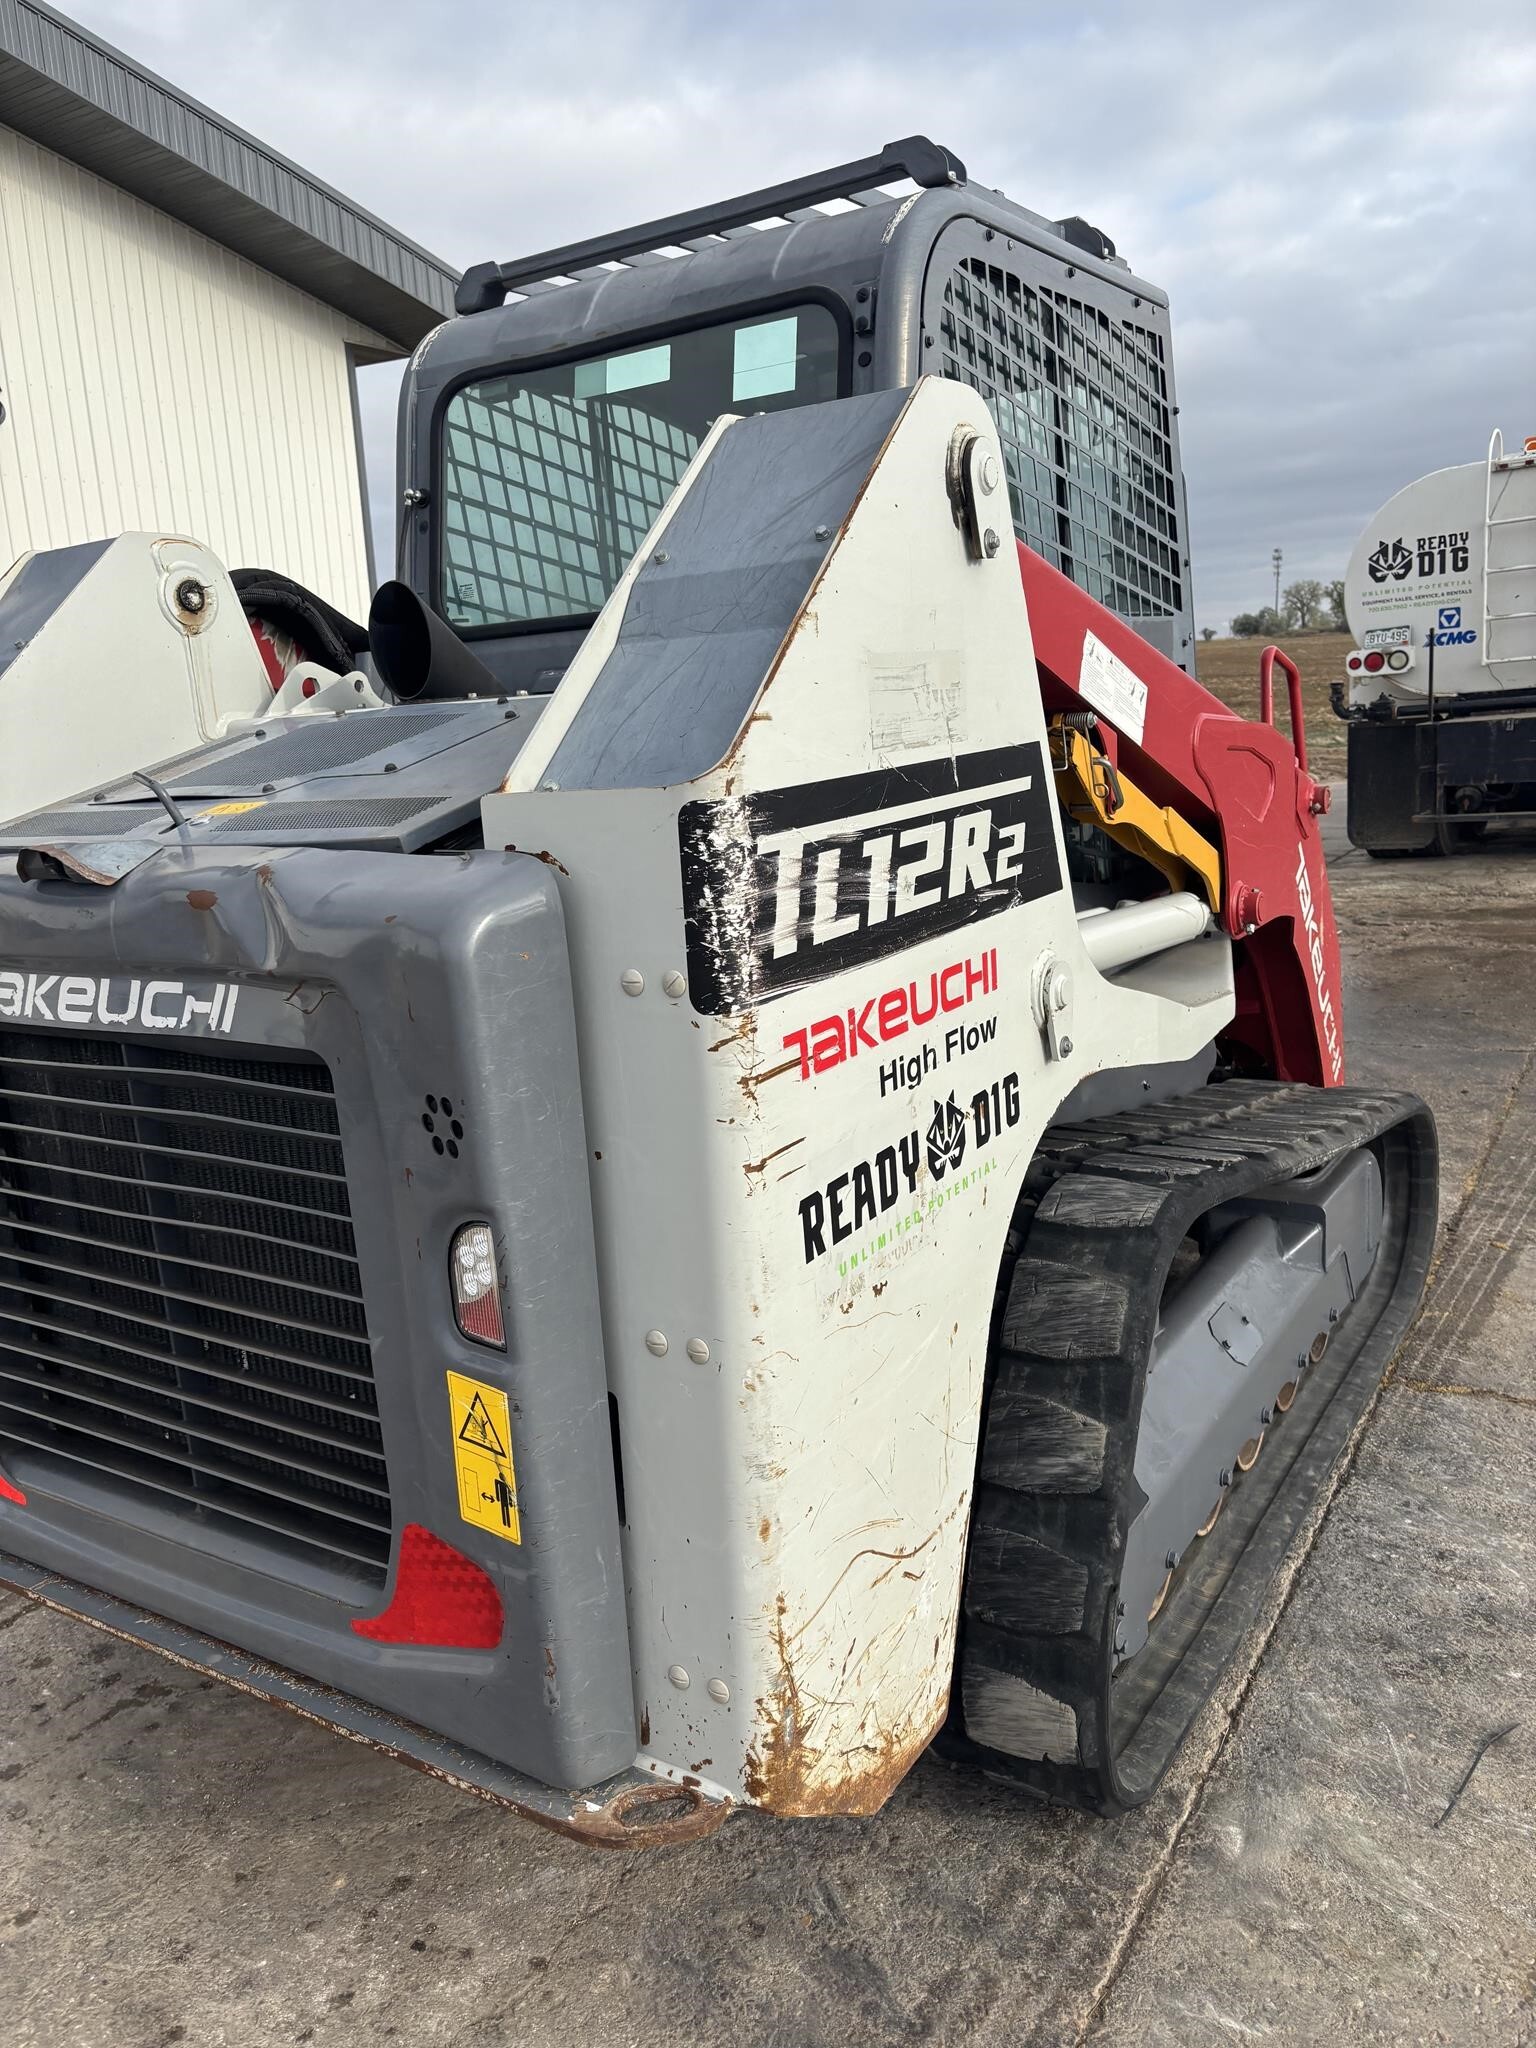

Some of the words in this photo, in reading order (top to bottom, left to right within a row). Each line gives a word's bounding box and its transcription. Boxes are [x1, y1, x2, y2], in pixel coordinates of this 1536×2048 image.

[1416, 531, 1469, 551] READY
[1362, 586, 1413, 597] UNLIMITED
[1418, 580, 1472, 590] POTENTIAL
[1362, 597, 1393, 606] EQUIPMENT
[1423, 630, 1477, 648] XCMG
[757, 775, 1033, 960] TL12R2
[0, 971, 239, 1033] AKEUCHI
[879, 1046, 937, 1098] High
[946, 1016, 998, 1063] Flow
[798, 1136, 921, 1265] READY
[839, 1211, 923, 1278] UNLIMITED
[927, 1157, 999, 1213] POTENTIAL
